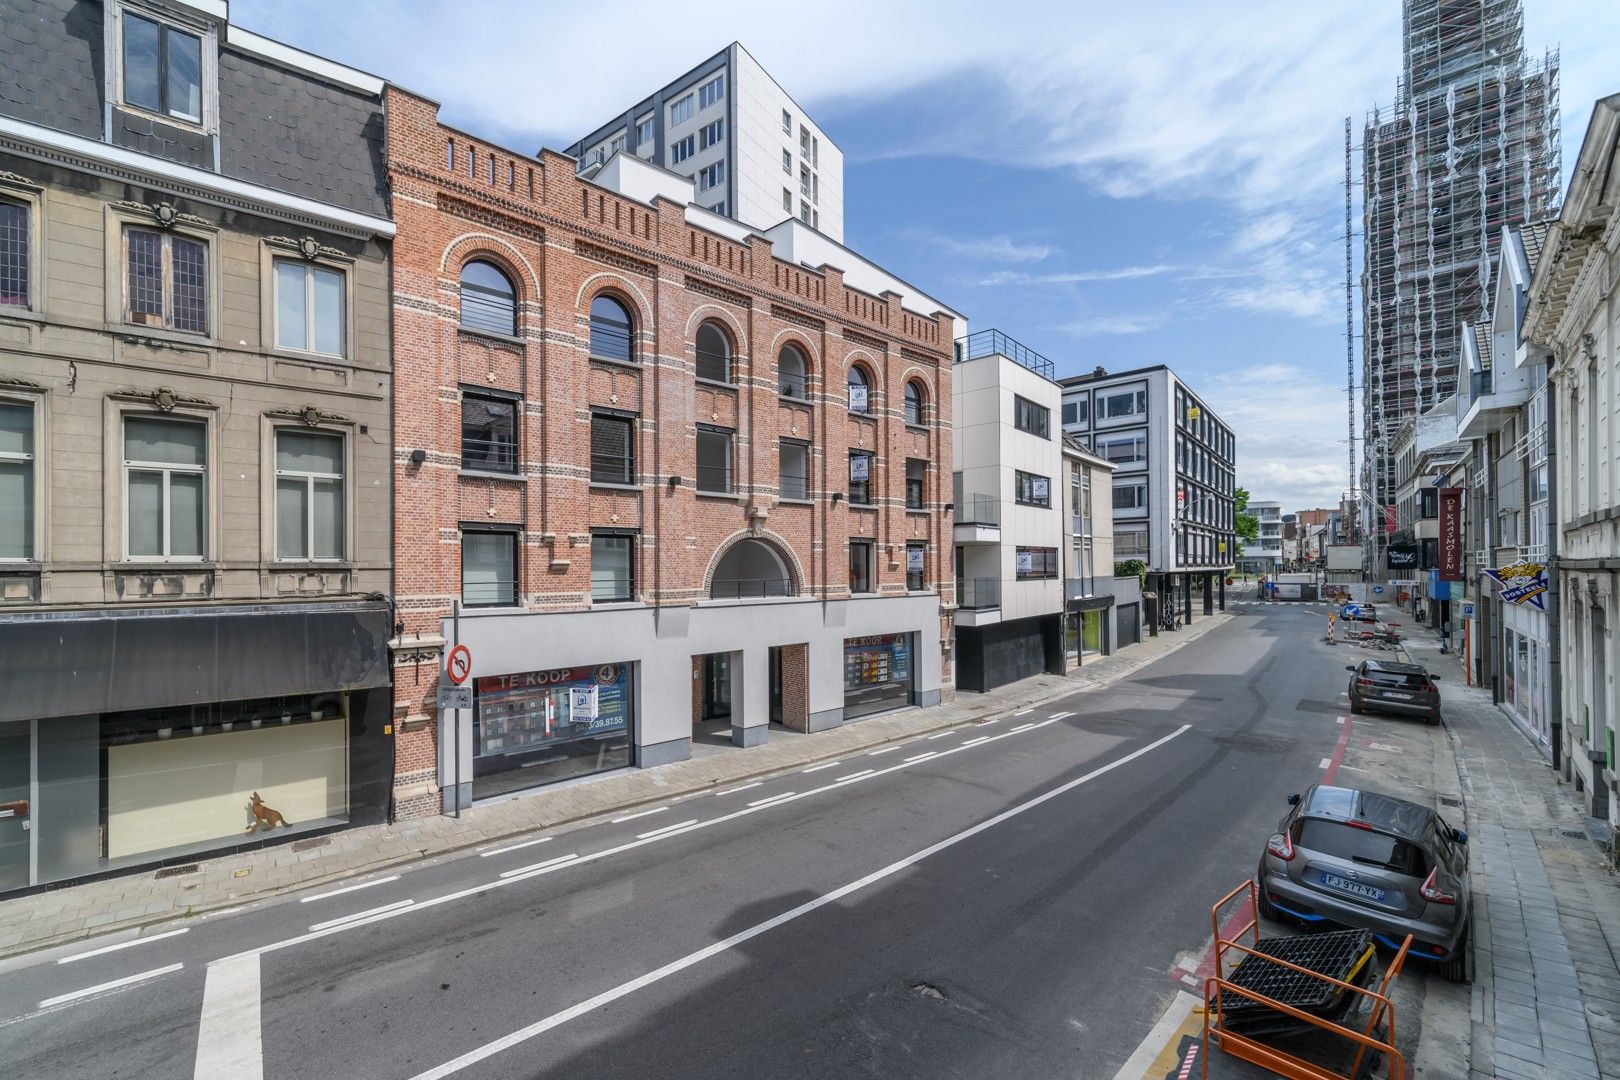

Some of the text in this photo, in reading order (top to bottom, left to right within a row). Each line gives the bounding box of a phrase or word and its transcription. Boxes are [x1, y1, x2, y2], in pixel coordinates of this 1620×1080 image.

[1446, 499, 1455, 511] DE
[1446, 513, 1455, 570] KAASMOLEN
[498, 671, 571, 688] TE KOOP
